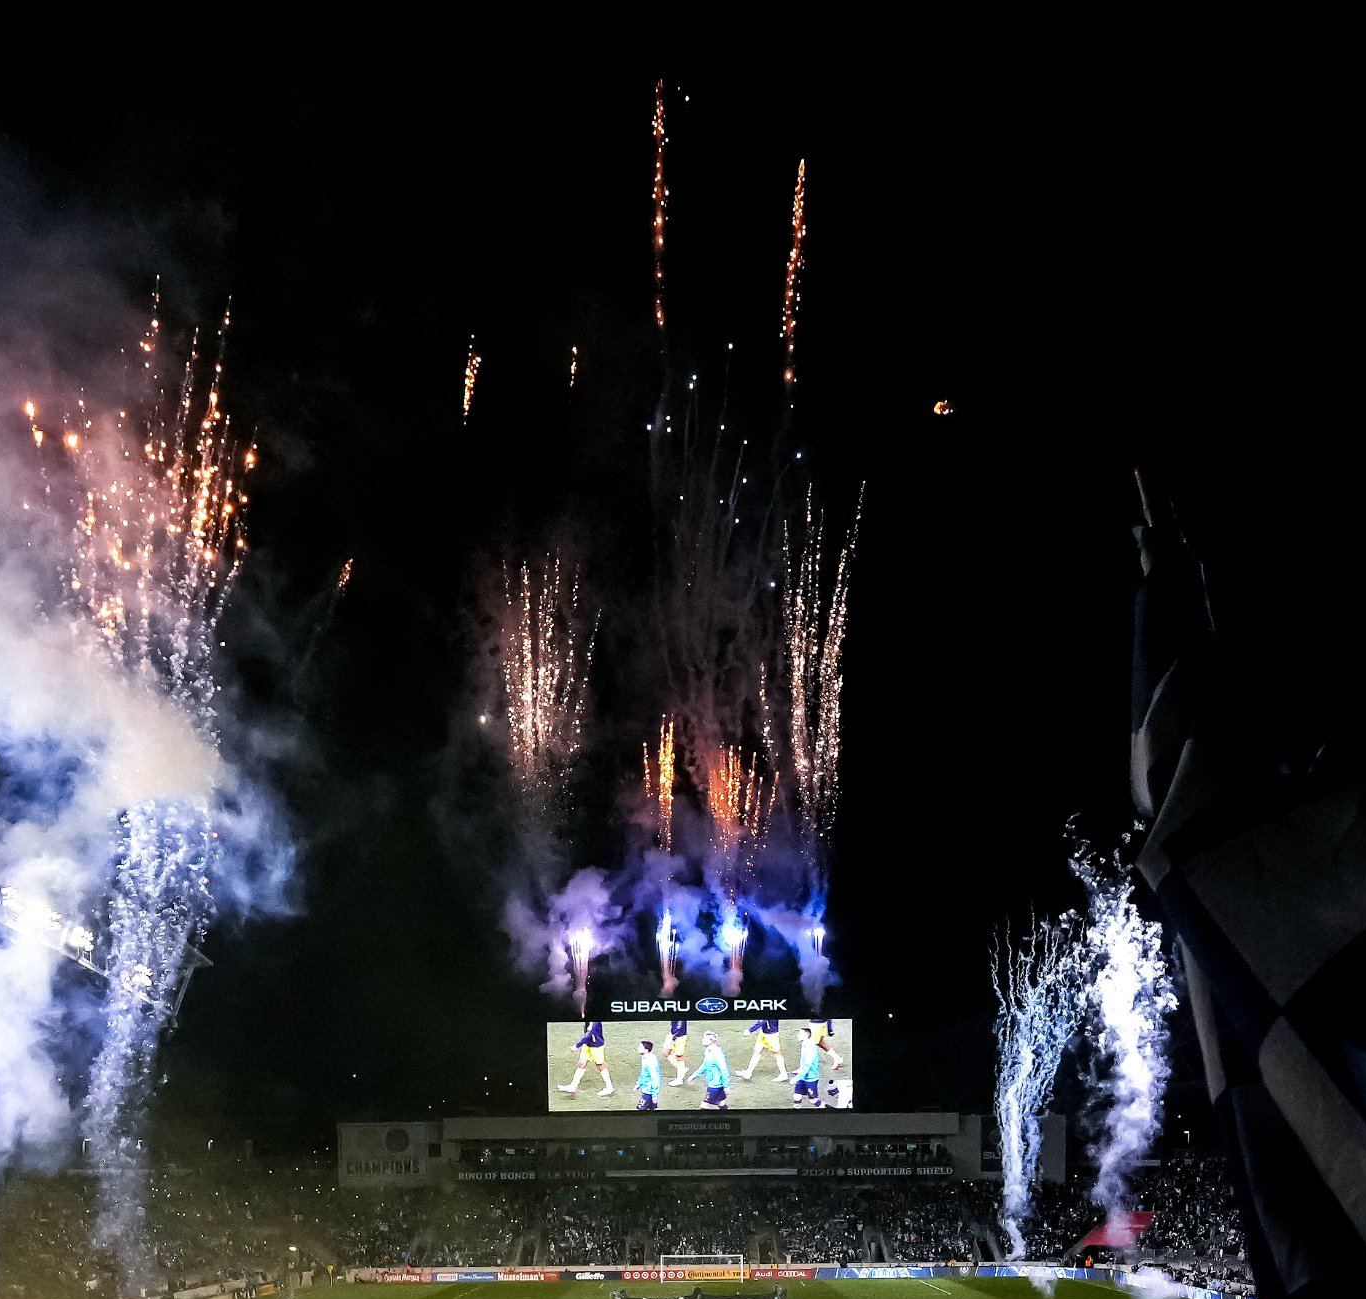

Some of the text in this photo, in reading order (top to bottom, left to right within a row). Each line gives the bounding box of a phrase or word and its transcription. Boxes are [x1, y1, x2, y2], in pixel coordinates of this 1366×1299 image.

[610, 999, 787, 1013] SUBARU PARK
[458, 1171, 483, 1181] RING
[485, 1171, 498, 1181] OF
[500, 1171, 534, 1181] HONOR
[915, 1166, 953, 1176] SHIELD
[497, 1272, 544, 1282] Musselman's
[575, 1272, 605, 1281] Gillette
[687, 1270, 725, 1279] Continental
[755, 1270, 773, 1278] Audi
